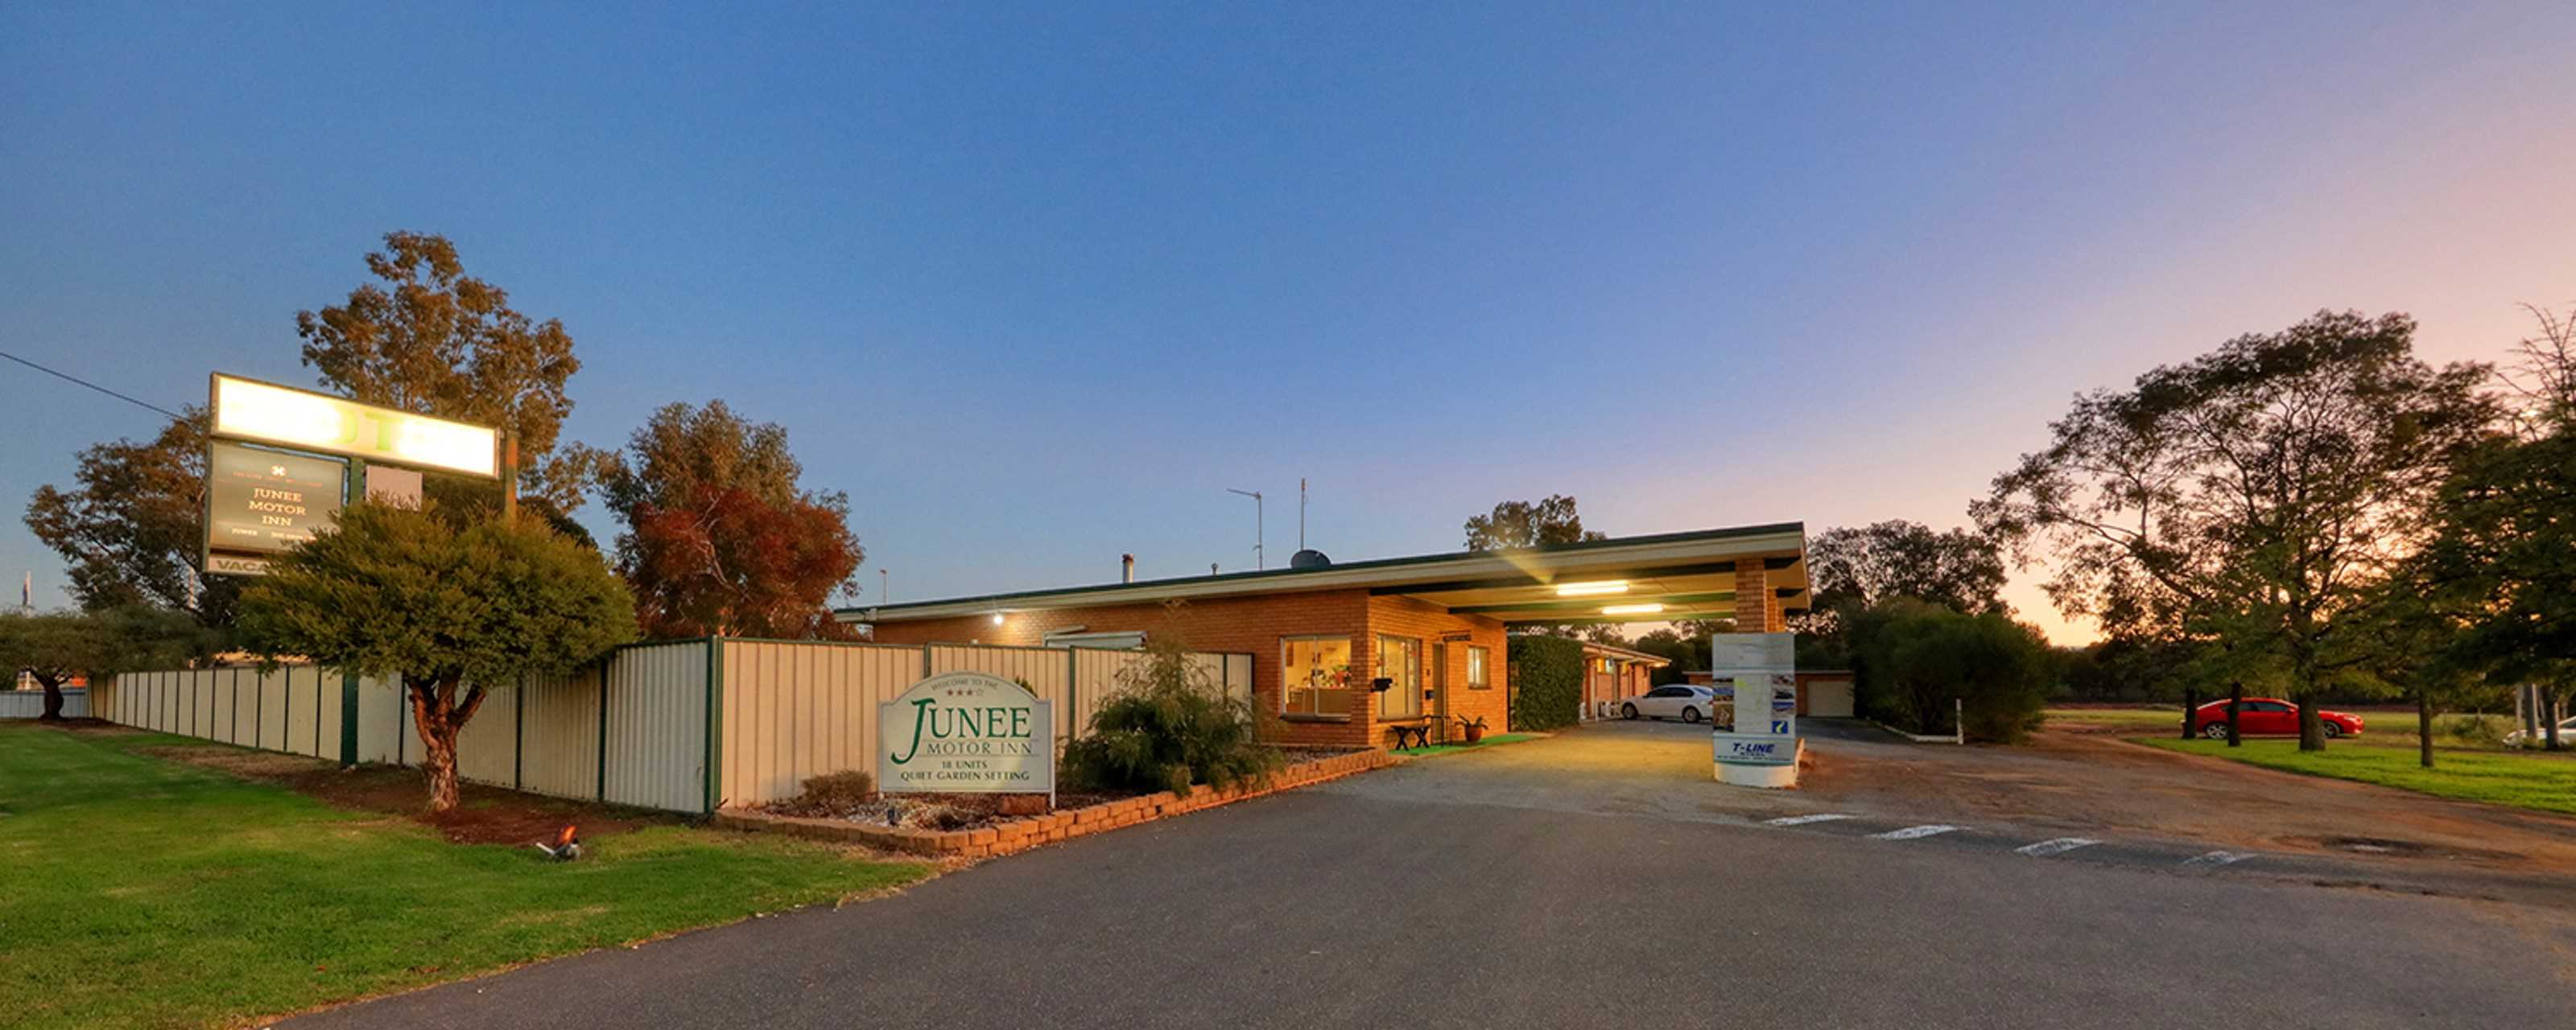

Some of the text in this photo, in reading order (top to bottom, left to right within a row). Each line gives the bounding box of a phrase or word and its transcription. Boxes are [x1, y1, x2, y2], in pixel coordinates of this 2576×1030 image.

[253, 487, 302, 503] JUNEE
[248, 500, 307, 516] MOTOR
[262, 514, 292, 527] INN
[217, 559, 270, 573] VACA
[890, 698, 1031, 764] JUNEE
[927, 741, 1031, 755] MOTOR INN
[1732, 742, 1776, 754] T-LINE
[942, 760, 988, 769] 18 UNITS
[901, 771, 1030, 782] QUIET GARDEN SETTING
